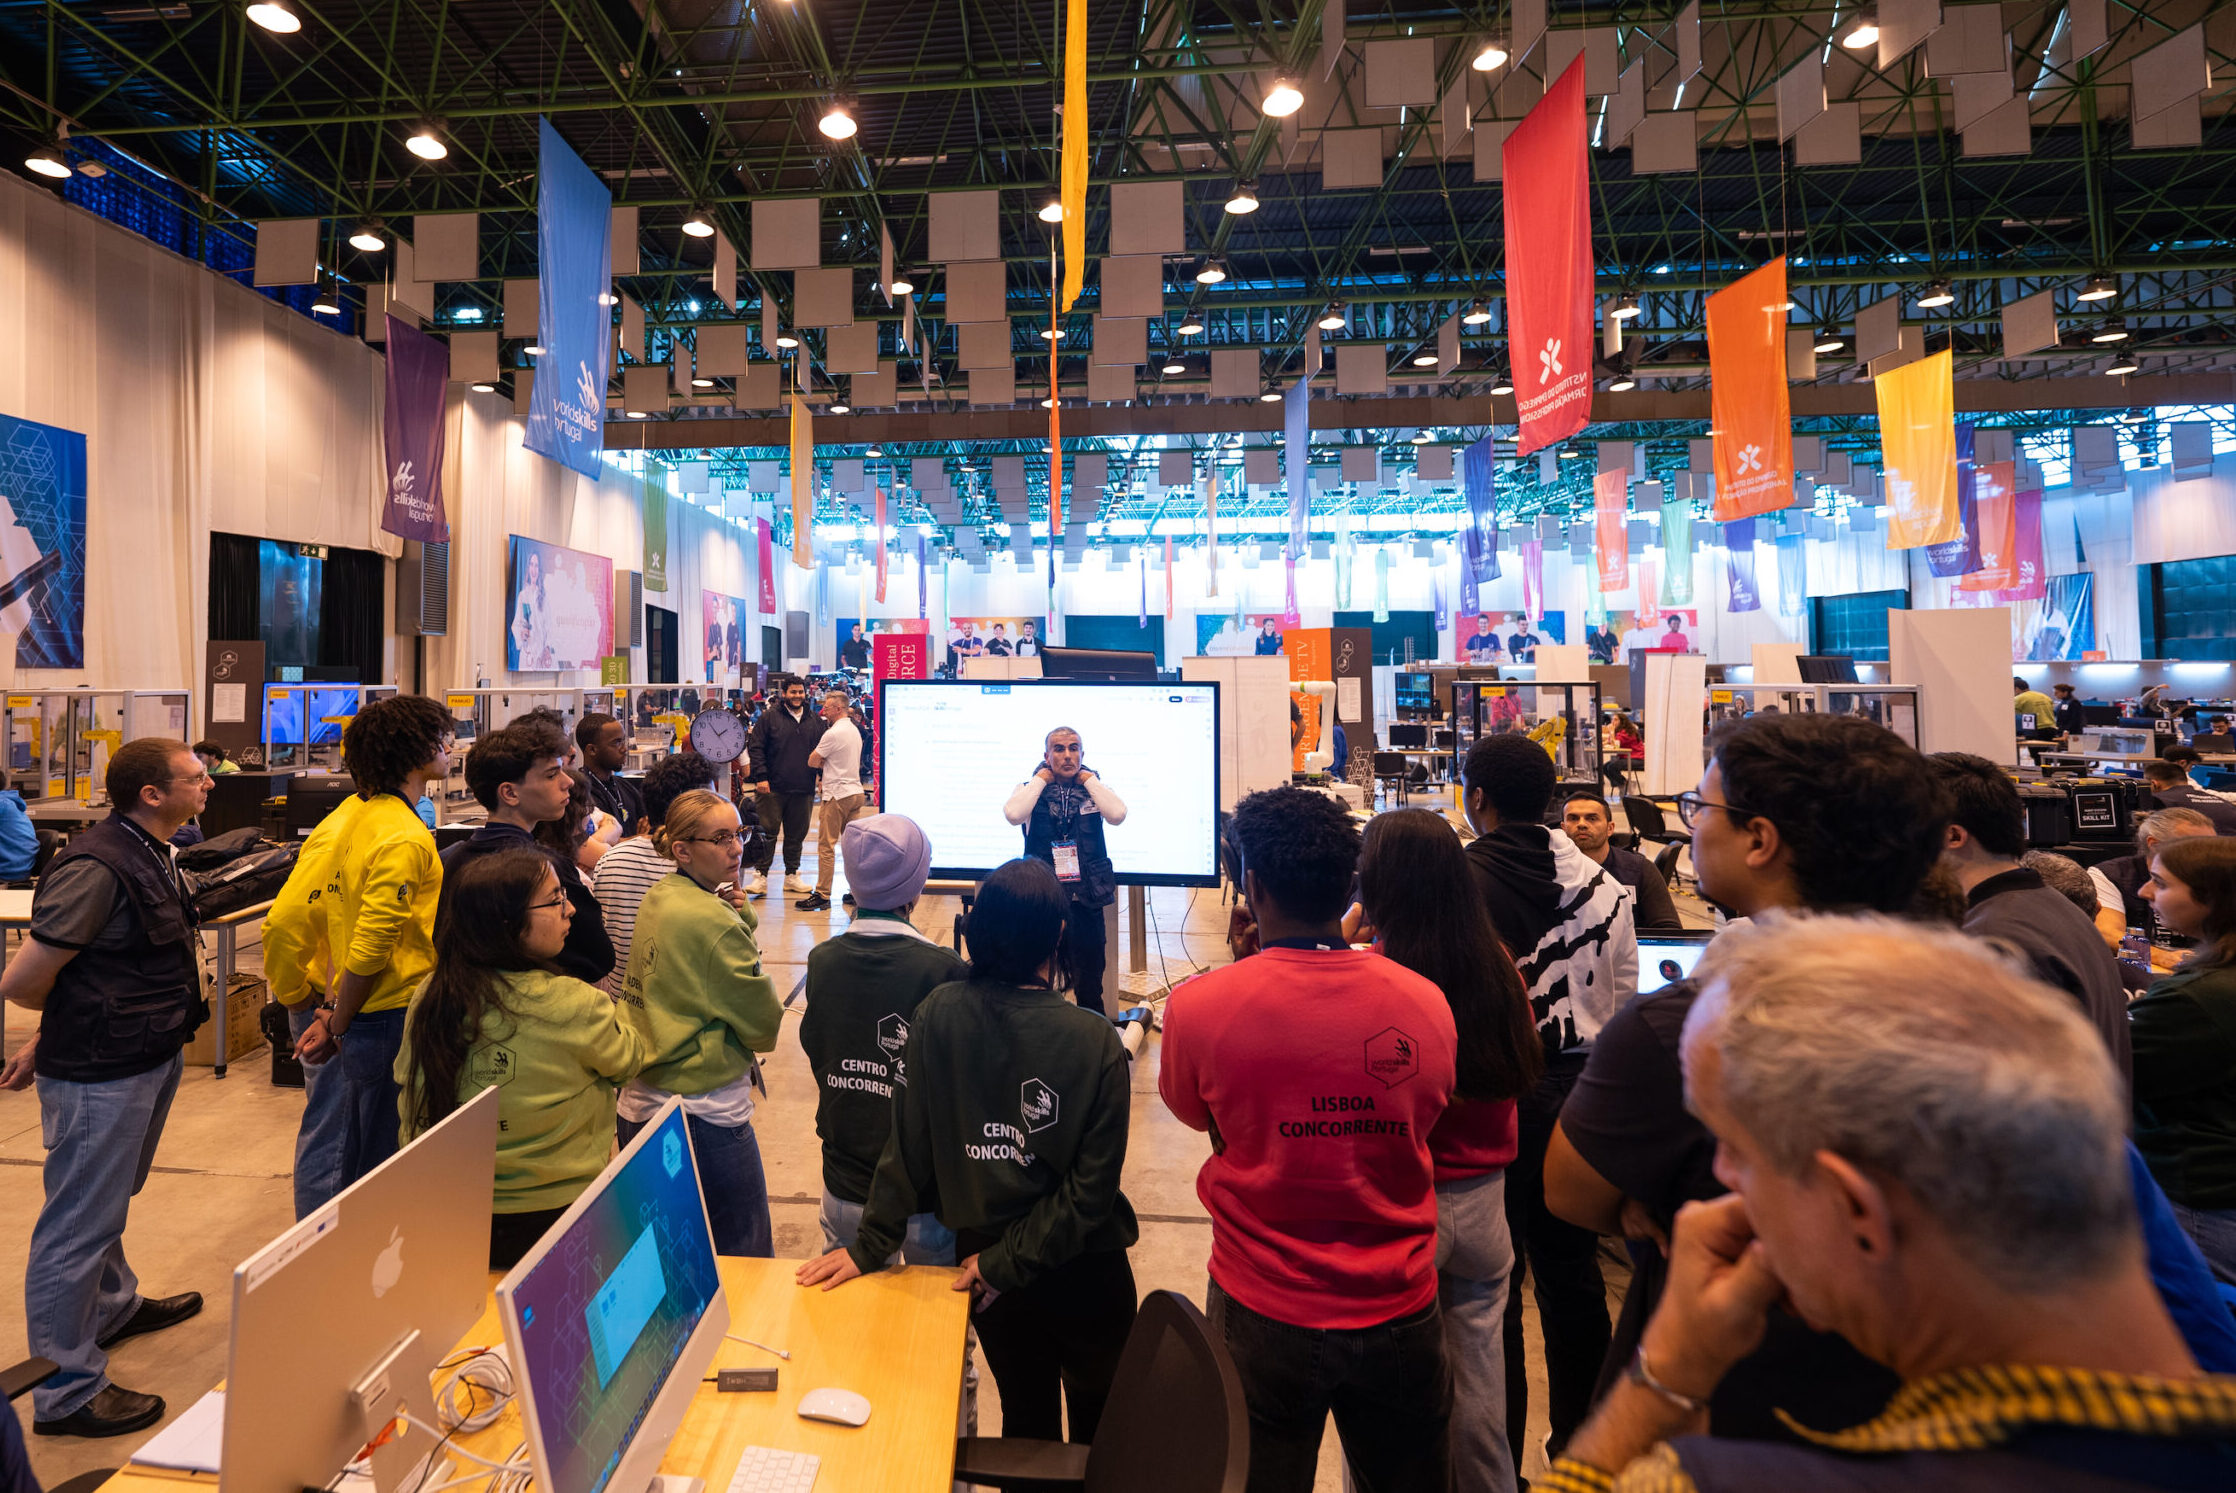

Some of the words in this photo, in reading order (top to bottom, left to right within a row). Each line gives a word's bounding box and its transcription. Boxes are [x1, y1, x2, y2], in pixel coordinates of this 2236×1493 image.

[886, 644, 899, 679] Digital
[901, 644, 916, 679] RCE
[1296, 640, 1309, 660] TV
[841, 1058, 888, 1078] CENTRO
[827, 1073, 893, 1099] CONCORREN
[1312, 1096, 1376, 1113] LISBOA
[983, 1122, 1026, 1149] CENTRO
[1279, 1119, 1409, 1138] CONCORRENTE
